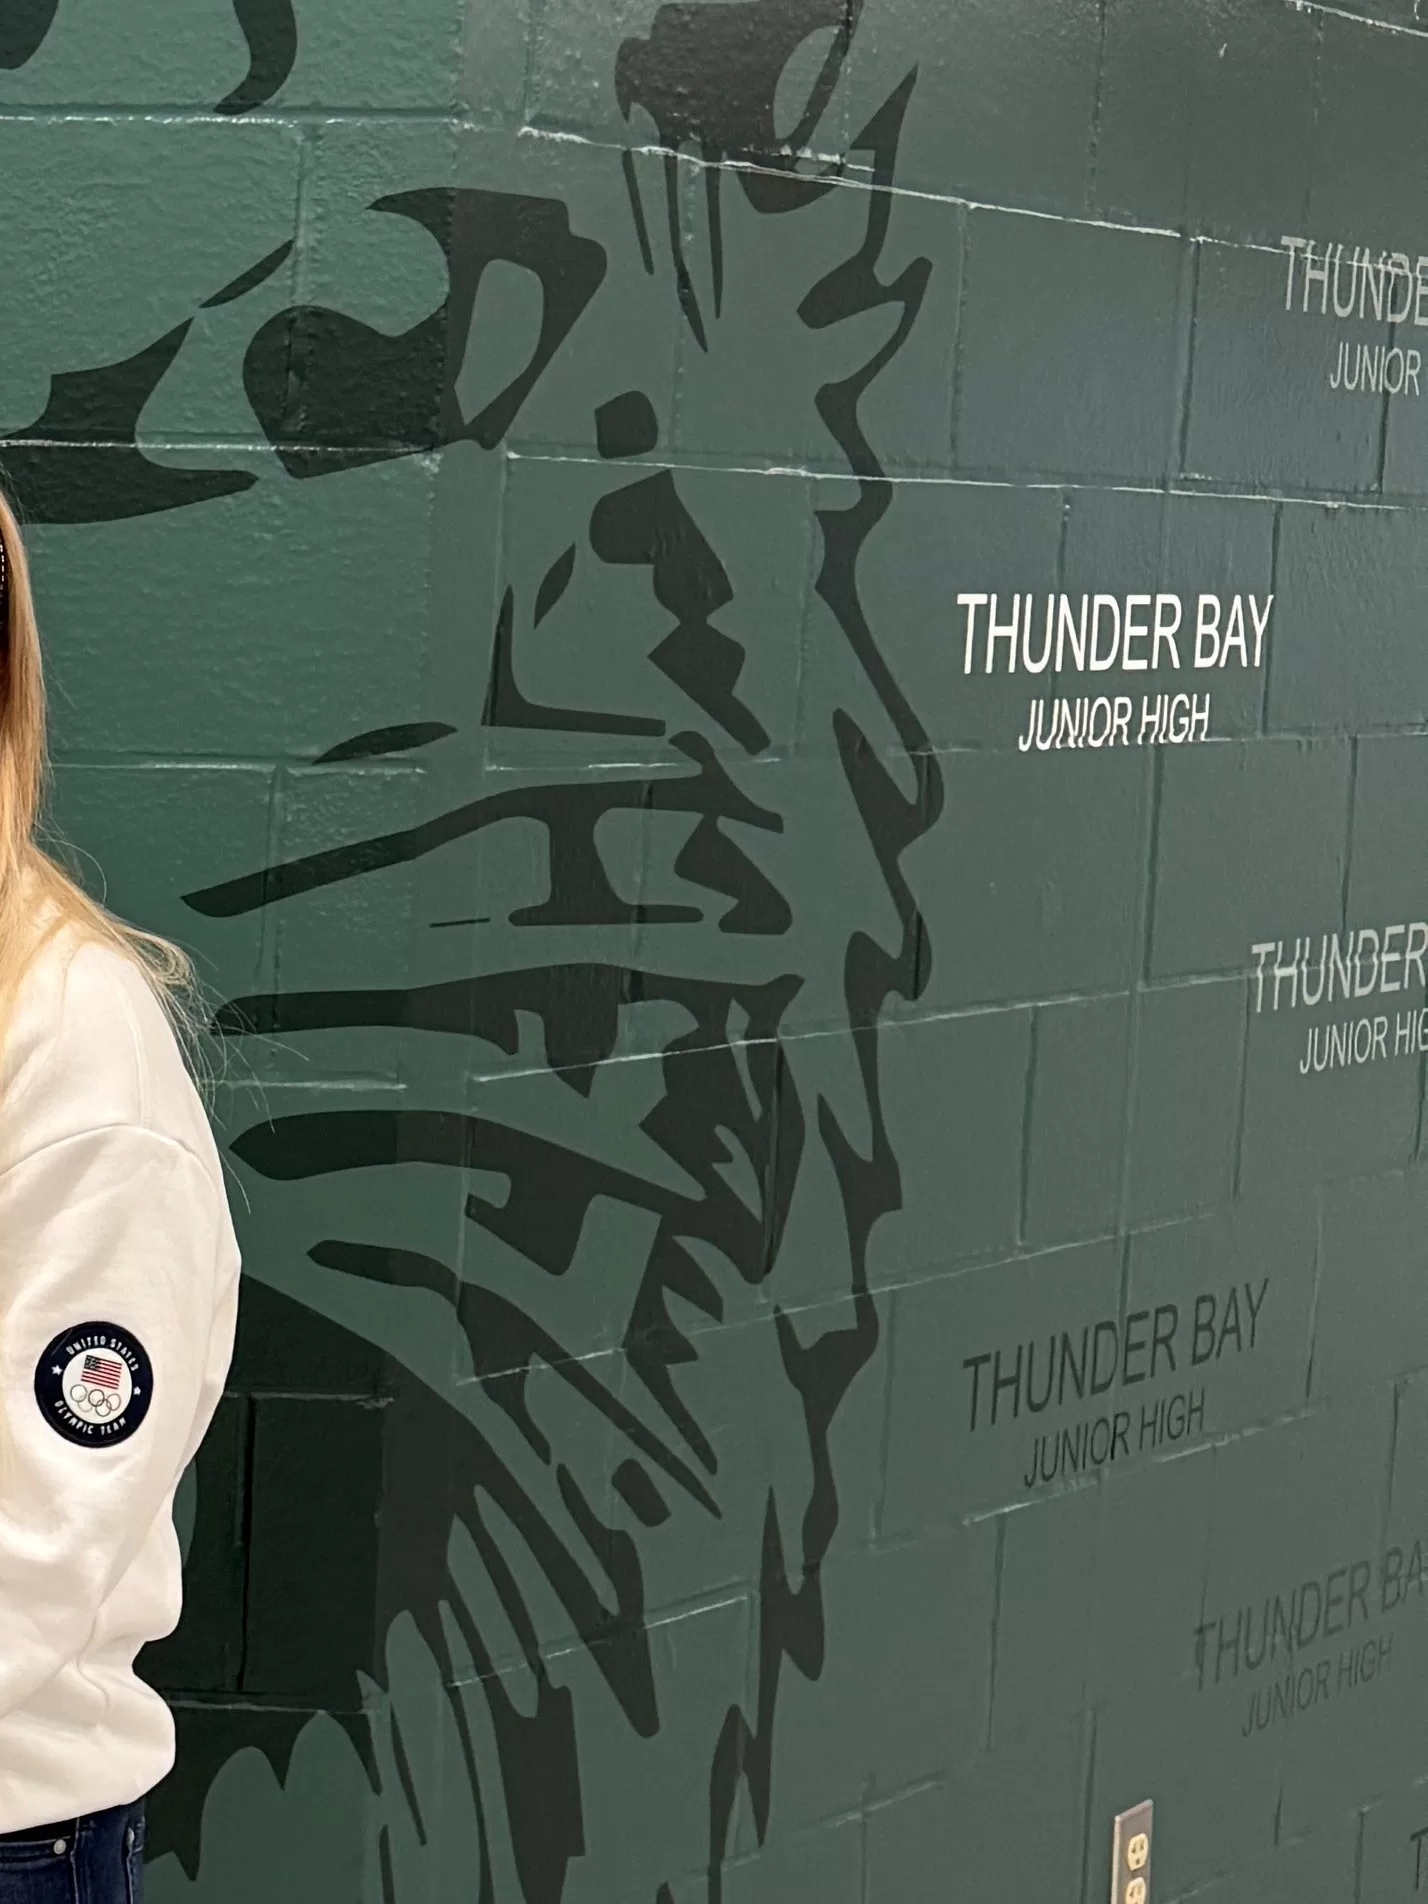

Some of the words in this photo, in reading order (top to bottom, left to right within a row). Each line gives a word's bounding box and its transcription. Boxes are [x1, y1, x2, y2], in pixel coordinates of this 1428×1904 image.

[1330, 341, 1422, 397] JUNIOR
[956, 593, 1183, 674] THUNDER
[1192, 593, 1274, 669] BAY
[1017, 695, 1133, 752] JUNIOR
[1136, 692, 1211, 745] HIGH
[1251, 921, 1428, 1014] THUNDER
[1299, 1015, 1389, 1075] JUNIOR
[65, 1335, 106, 1355] UNITED
[110, 1338, 140, 1372] STATES
[962, 1303, 1180, 1431] THUNDER
[1190, 1277, 1271, 1366] BAY
[1023, 1410, 1130, 1489] JUNIOR
[1139, 1386, 1206, 1453] HIGH
[1194, 1559, 1372, 1692] THUNDER
[1242, 1657, 1331, 1738] JUNIOR
[1337, 1632, 1394, 1695] HIGH
